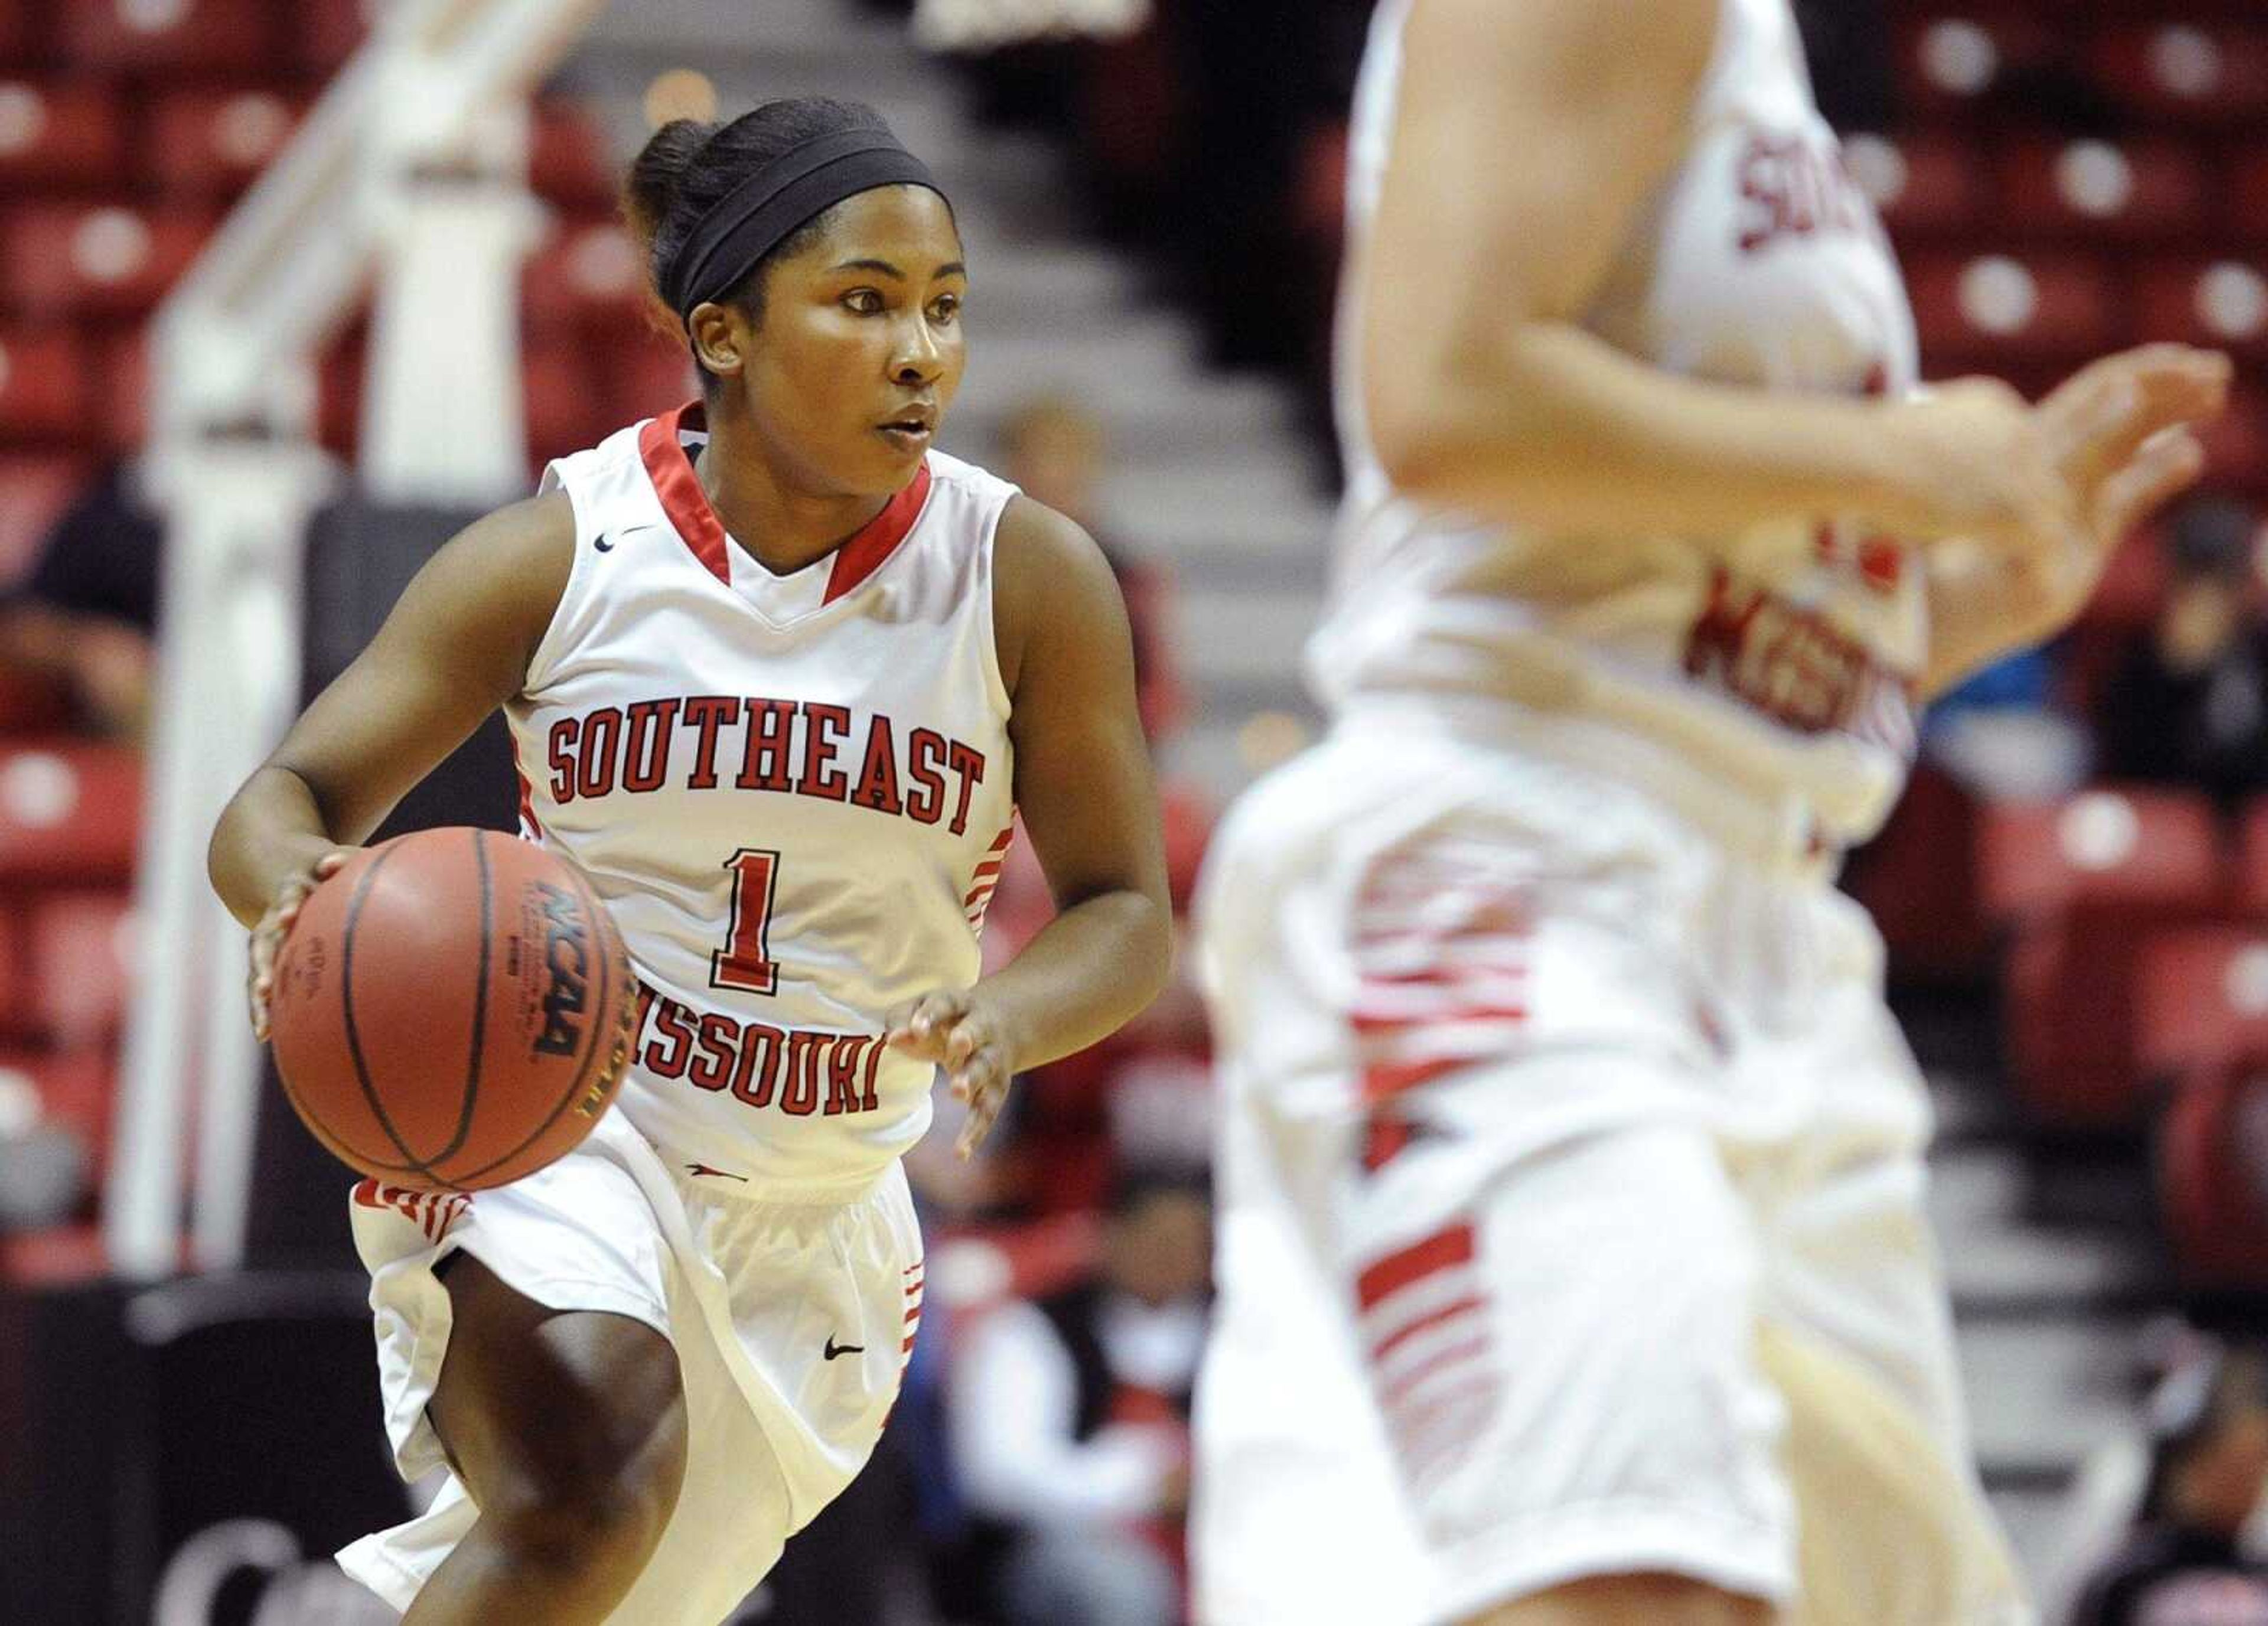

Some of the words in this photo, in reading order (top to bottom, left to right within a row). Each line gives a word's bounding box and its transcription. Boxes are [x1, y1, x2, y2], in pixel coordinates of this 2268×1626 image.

[548, 696, 985, 836] SOUTHEAST
[532, 882, 589, 1055] NCAA
[710, 847, 780, 996] 1
[633, 980, 887, 1116] ISSOURI
